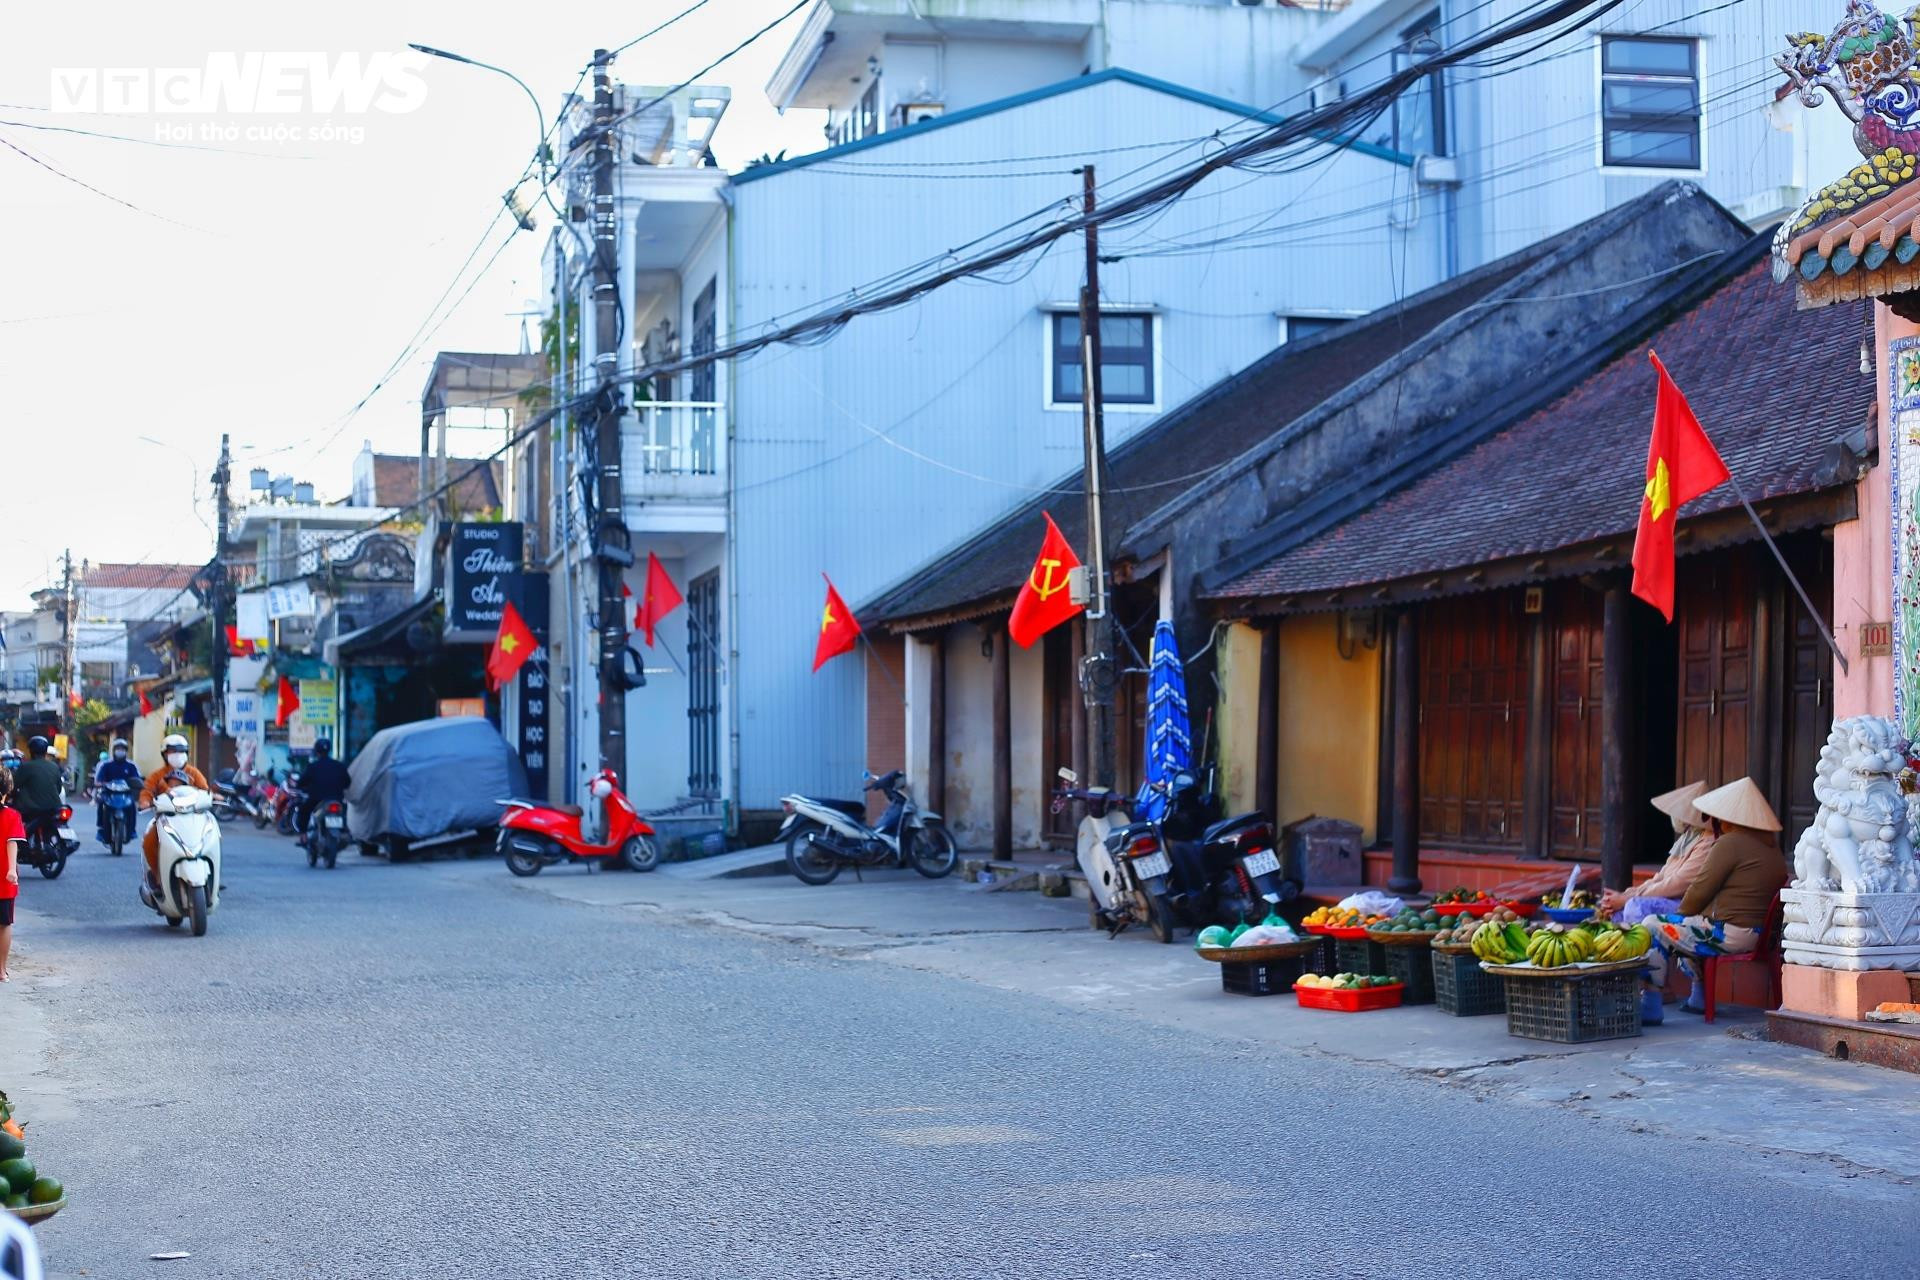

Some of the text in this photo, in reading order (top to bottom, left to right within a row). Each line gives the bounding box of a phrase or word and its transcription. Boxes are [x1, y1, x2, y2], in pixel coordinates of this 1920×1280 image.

[463, 529, 500, 540] STUDIO
[1864, 625, 1888, 646] 101
[526, 727, 544, 745] HỌC
[526, 751, 544, 768] VIÊN
